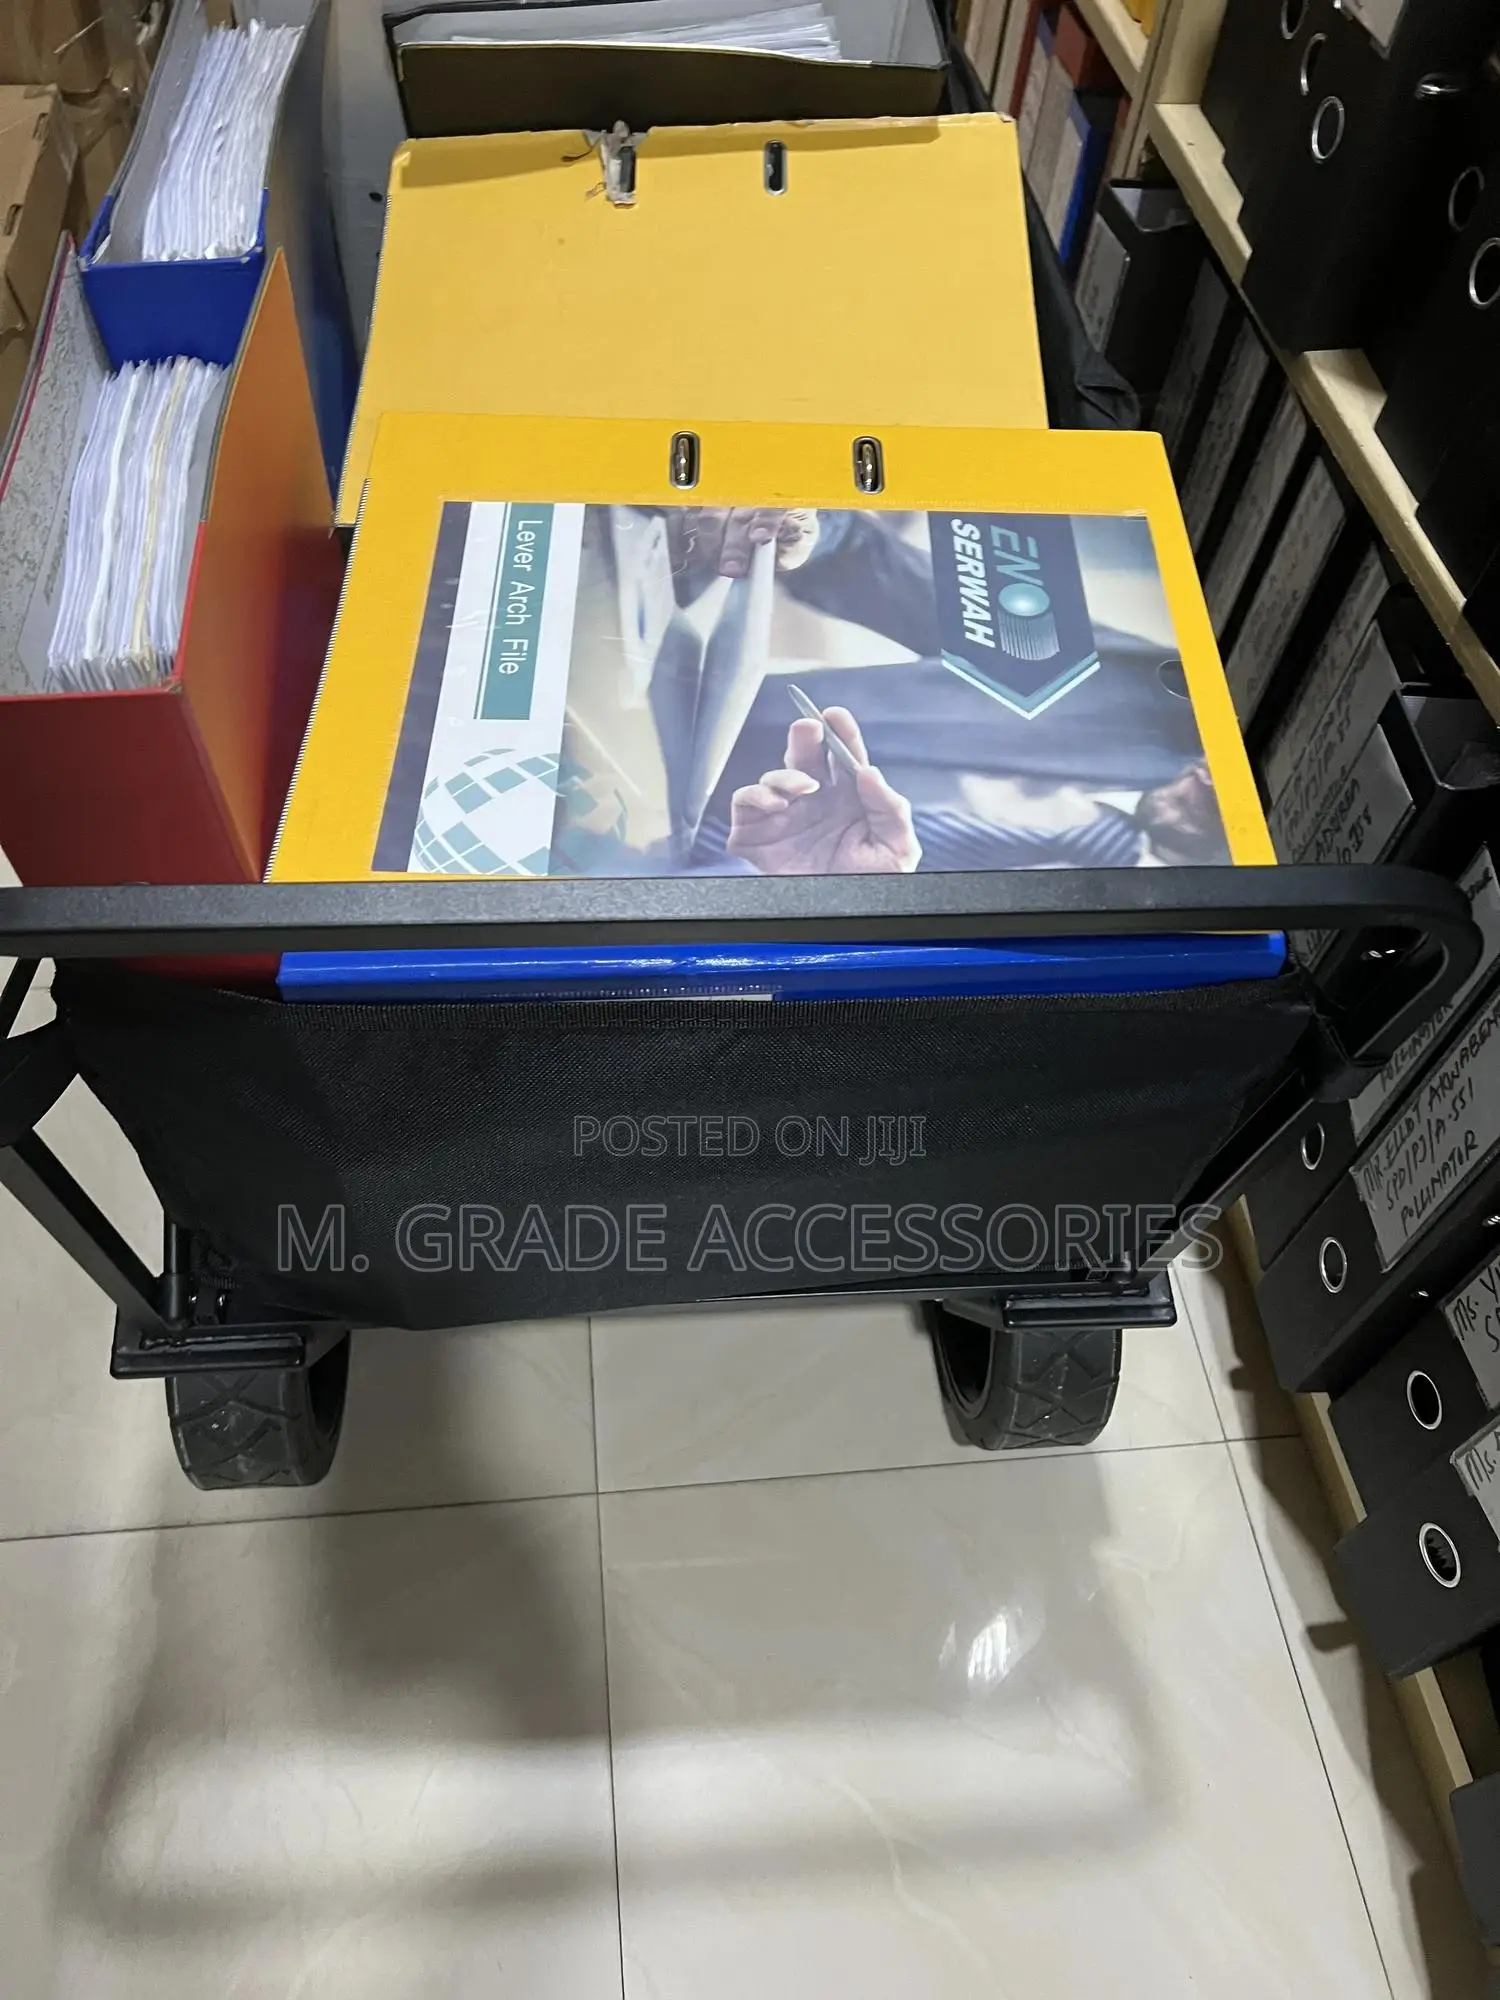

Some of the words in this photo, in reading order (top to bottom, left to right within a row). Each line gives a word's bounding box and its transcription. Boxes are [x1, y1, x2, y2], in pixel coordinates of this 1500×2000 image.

[512, 520, 544, 572] Lever
[505, 580, 536, 625] Arch
[950, 518, 996, 648] SERWAH
[498, 638, 529, 675] File
